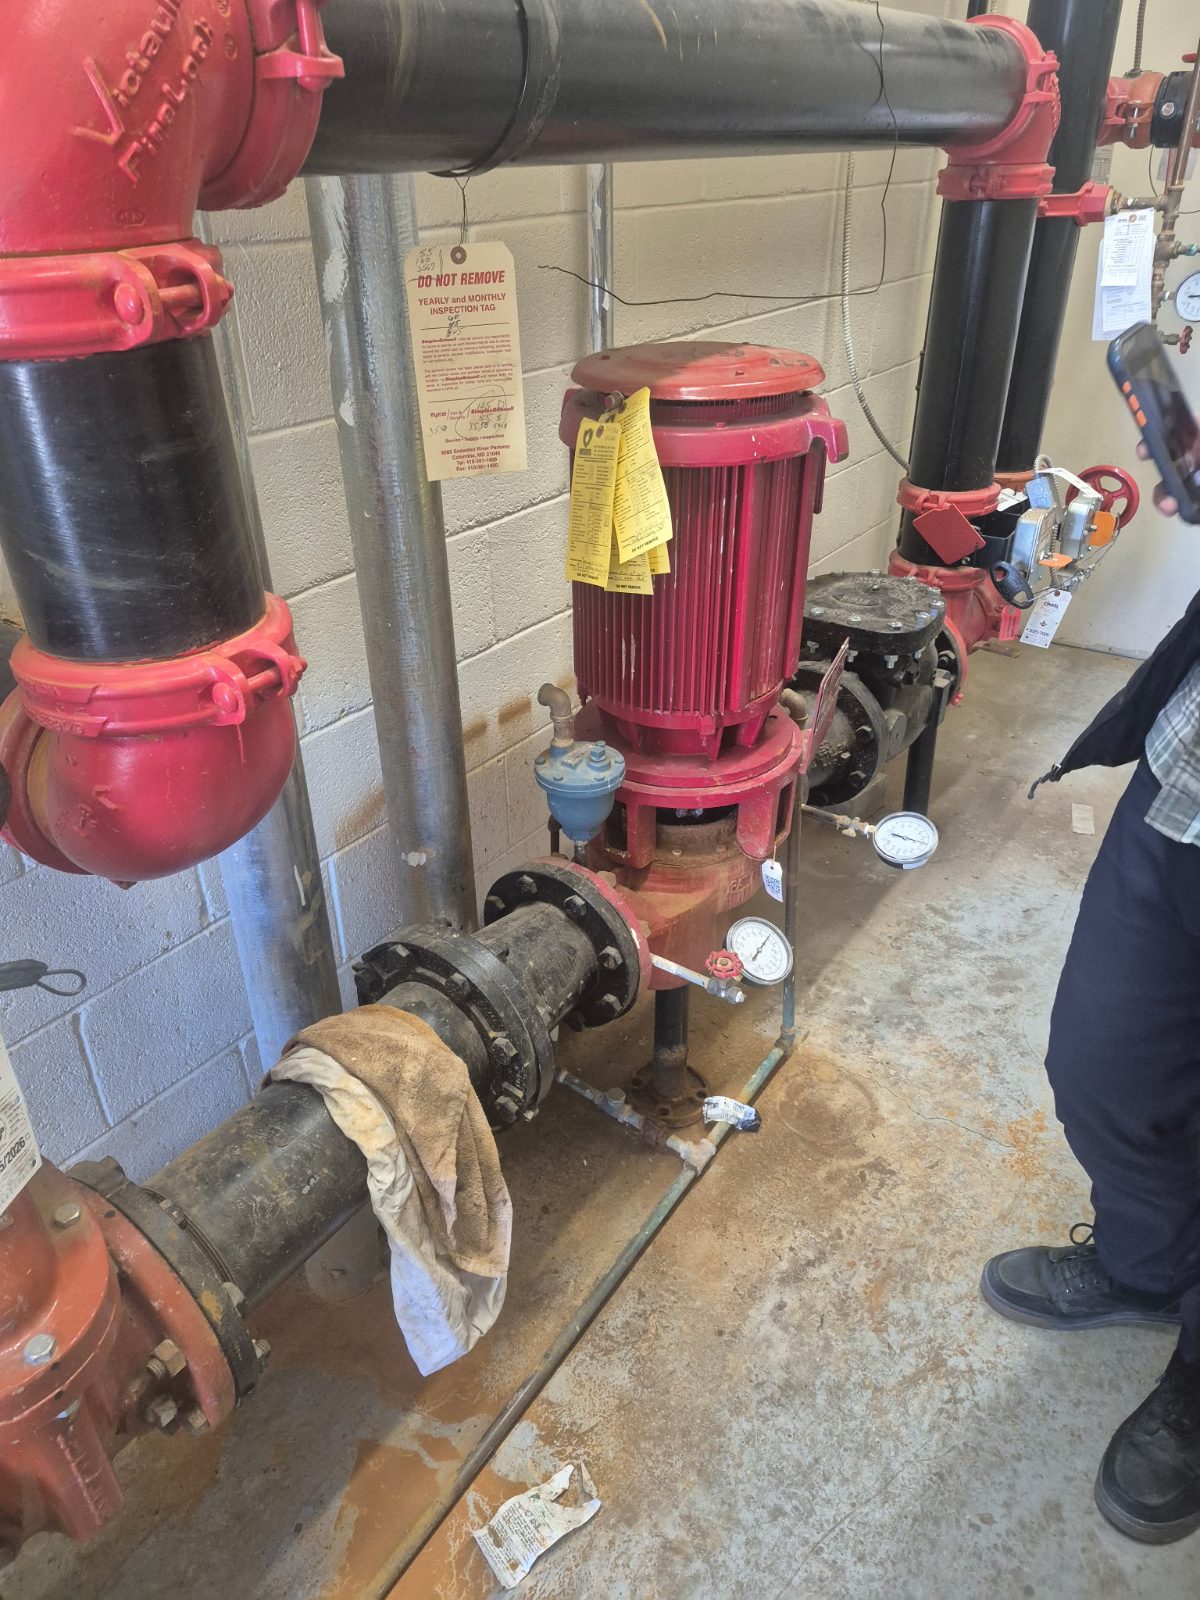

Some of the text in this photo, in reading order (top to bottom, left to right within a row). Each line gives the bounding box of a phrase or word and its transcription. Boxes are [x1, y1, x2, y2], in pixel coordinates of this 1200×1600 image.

[71, 0, 179, 147] Victaul
[417, 270, 505, 288] DO NOT REMOVE
[418, 293, 506, 306] YEARLY and MONTHLY
[430, 303, 496, 315] INSPECTION TAG
[0, 1136, 26, 1172] 5/2026
